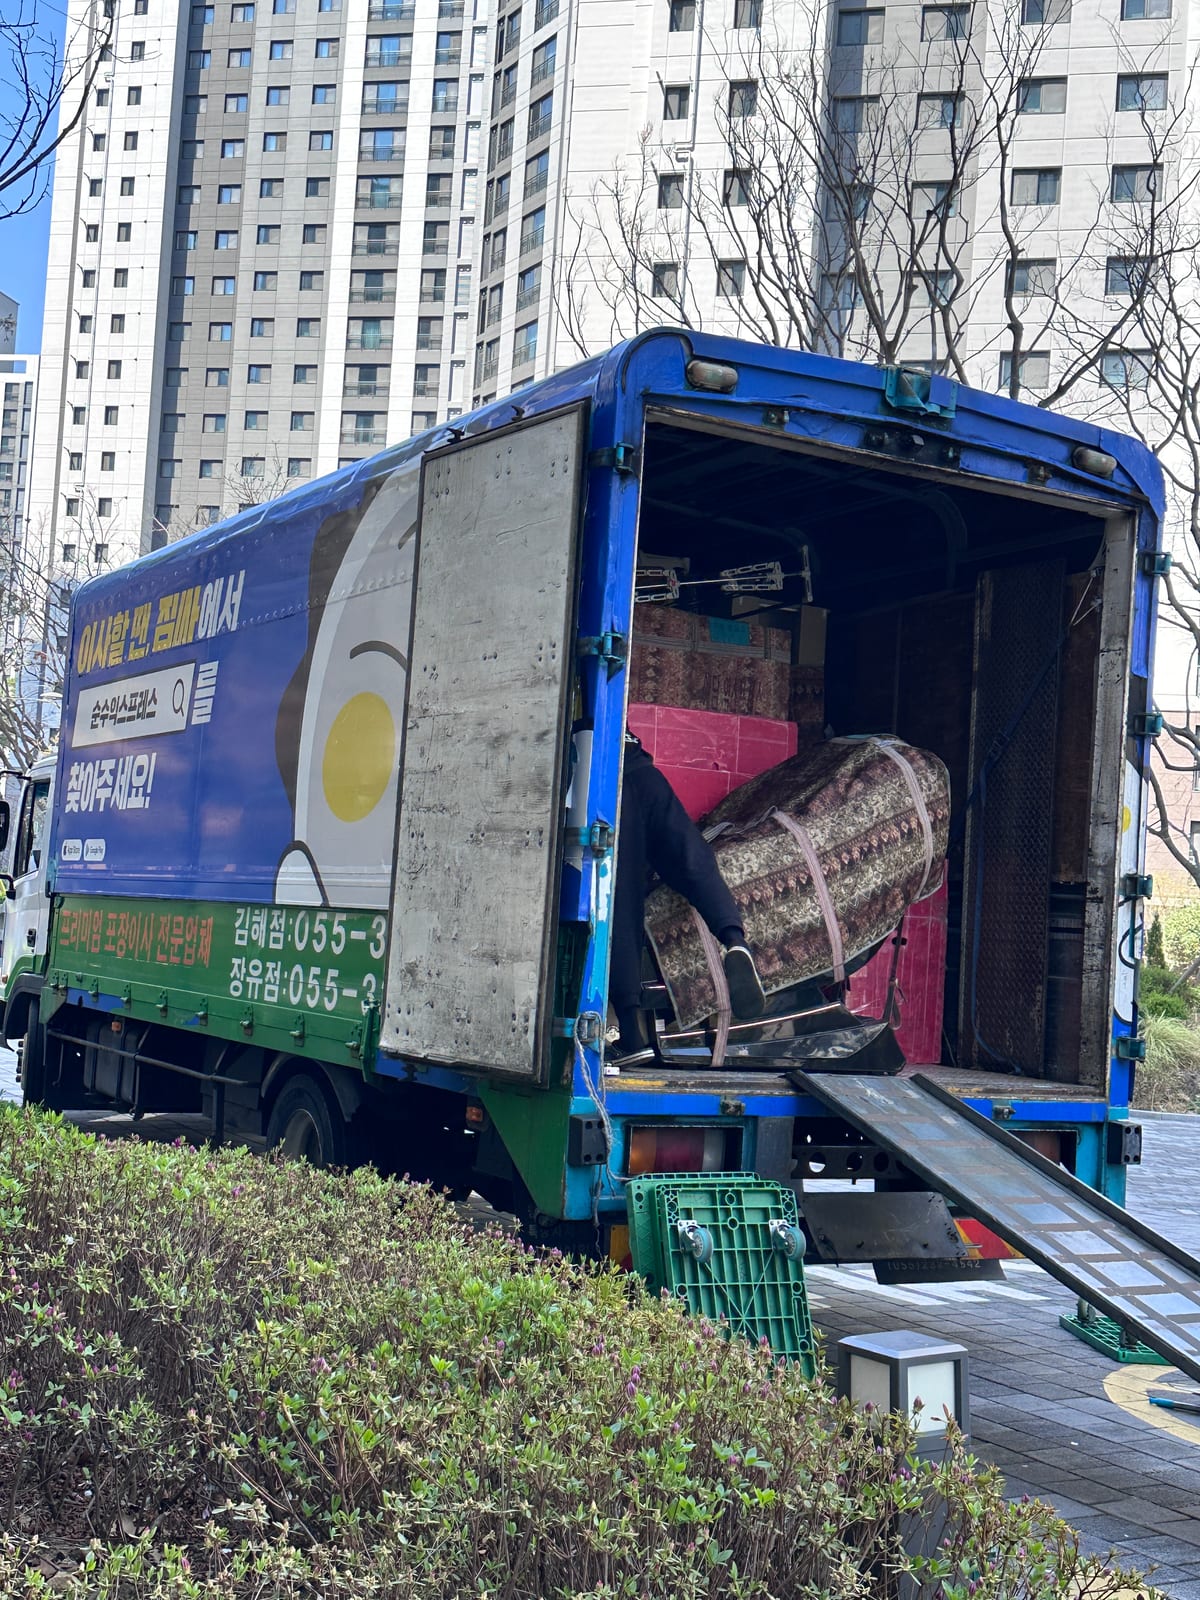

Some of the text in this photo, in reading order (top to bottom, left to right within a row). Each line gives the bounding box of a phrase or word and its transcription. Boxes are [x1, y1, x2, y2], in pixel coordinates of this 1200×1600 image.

[77, 610, 130, 674] 이사할
[152, 569, 246, 652] 짐싸에서
[90, 687, 158, 729] 순수익스프레스
[191, 660, 219, 726] 를
[65, 752, 157, 813] 찾아주세요!
[60, 908, 213, 968] 프리미엄 포장이사 전문업체
[230, 957, 385, 1015] 장유점:055-3
